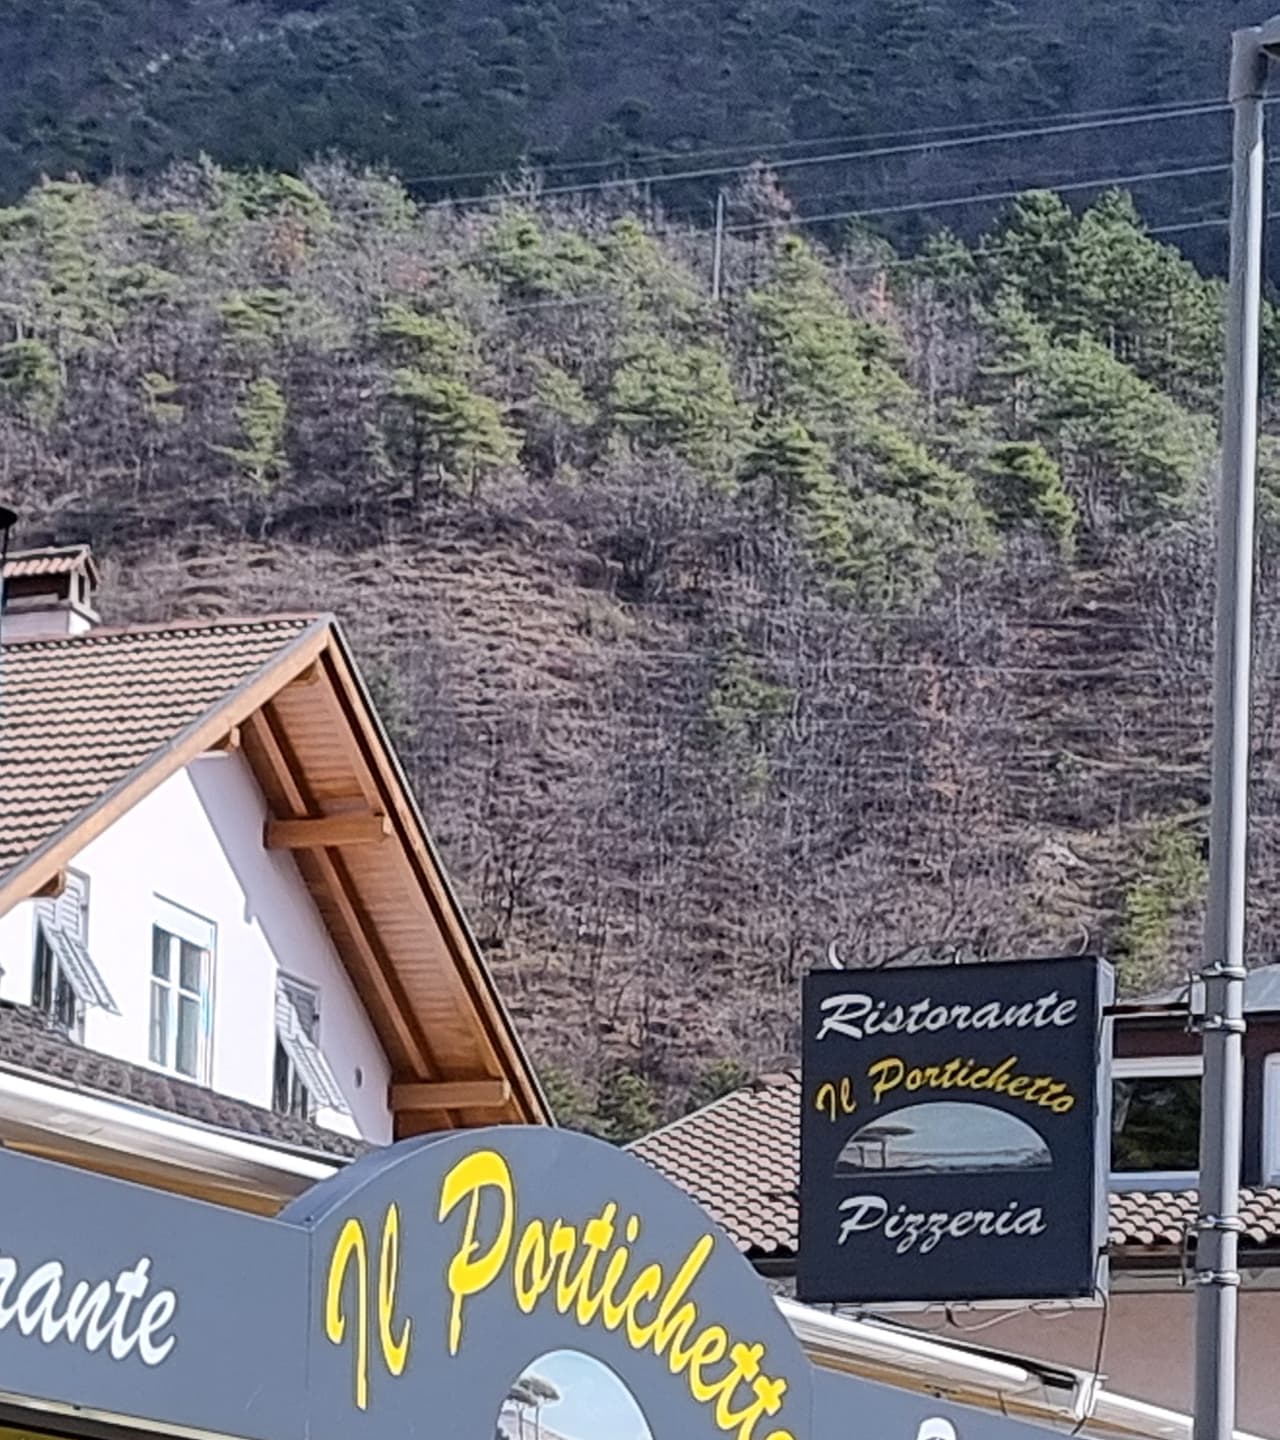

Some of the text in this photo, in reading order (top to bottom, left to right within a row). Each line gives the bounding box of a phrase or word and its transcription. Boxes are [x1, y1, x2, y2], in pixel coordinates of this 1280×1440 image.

[815, 990, 1078, 1041] Ristorante
[815, 1055, 1076, 1122] Il Portichetto
[837, 1194, 1048, 1254] Pizzeria
[325, 1201, 412, 1411] Il
